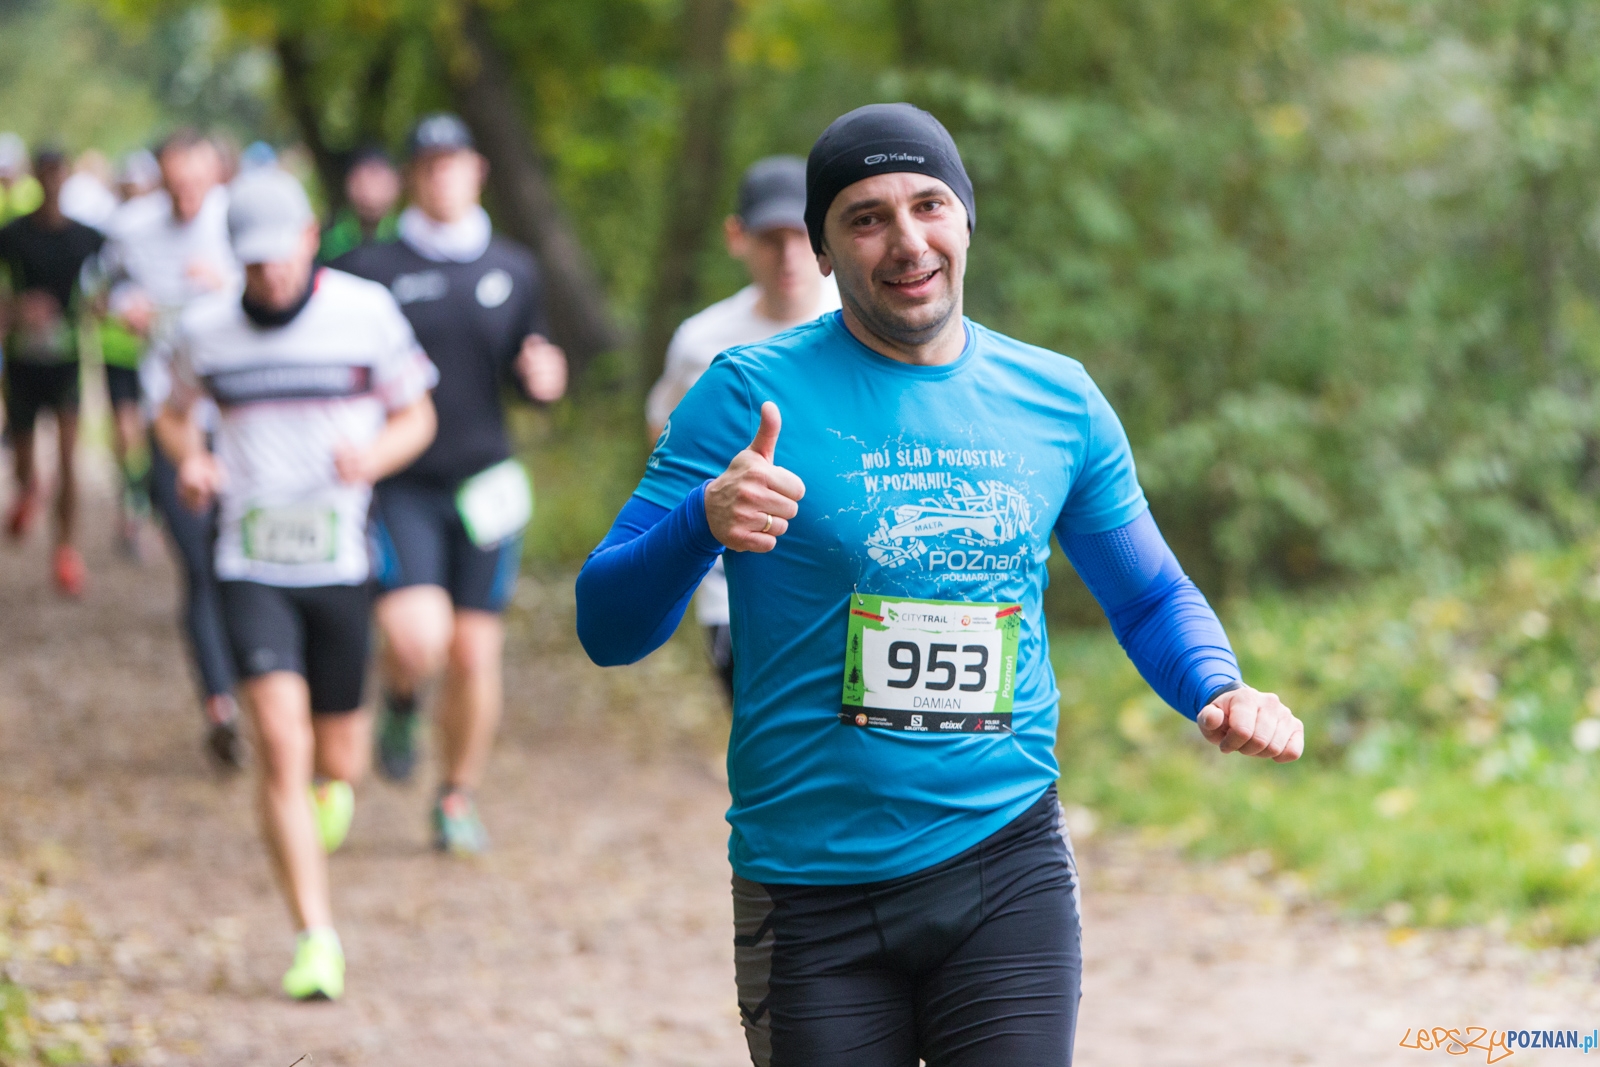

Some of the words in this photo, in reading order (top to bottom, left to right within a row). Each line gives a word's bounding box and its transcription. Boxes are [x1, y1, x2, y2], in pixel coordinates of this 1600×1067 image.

[937, 448, 1007, 468] POZOSTAŁ
[864, 475, 879, 493] W
[882, 472, 952, 491] POZNANIU
[914, 520, 944, 533] MALTA
[942, 572, 1009, 582] PÓŁMARATON
[886, 640, 989, 693] 953
[1001, 655, 1013, 699] Poznań
[913, 696, 961, 710] DAMIAN
